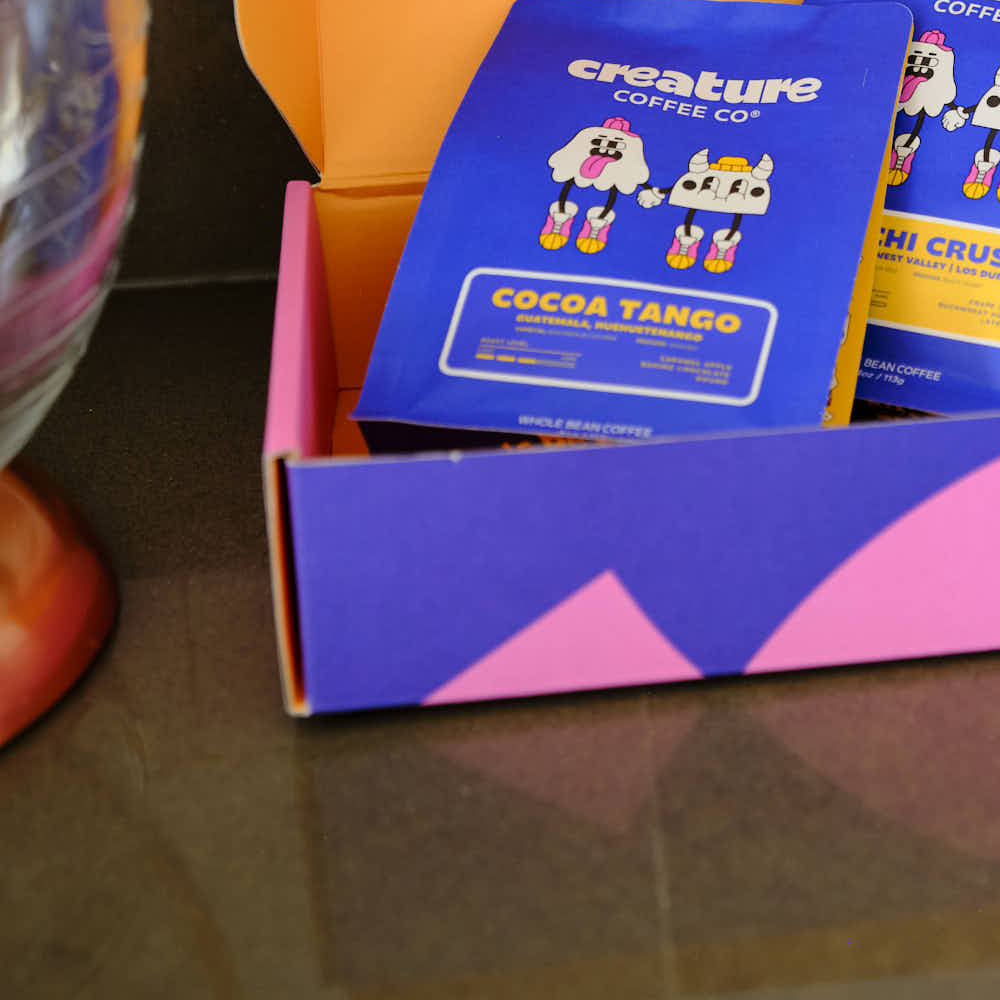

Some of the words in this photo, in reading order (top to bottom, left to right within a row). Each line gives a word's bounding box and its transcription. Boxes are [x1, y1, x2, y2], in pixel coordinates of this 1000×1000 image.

[567, 59, 823, 104] creature
[613, 89, 708, 119] COFFEE
[879, 227, 918, 252] HI
[906, 256, 946, 270] VALLEY
[956, 265, 977, 276] LOS
[492, 287, 608, 317] COCOA
[619, 299, 742, 334] TANGO
[863, 358, 896, 372] BEAN
[897, 364, 942, 381] COFFEE
[518, 415, 563, 429] WHOLE
[565, 419, 600, 433] BEAN
[602, 423, 653, 438] COFFEE
